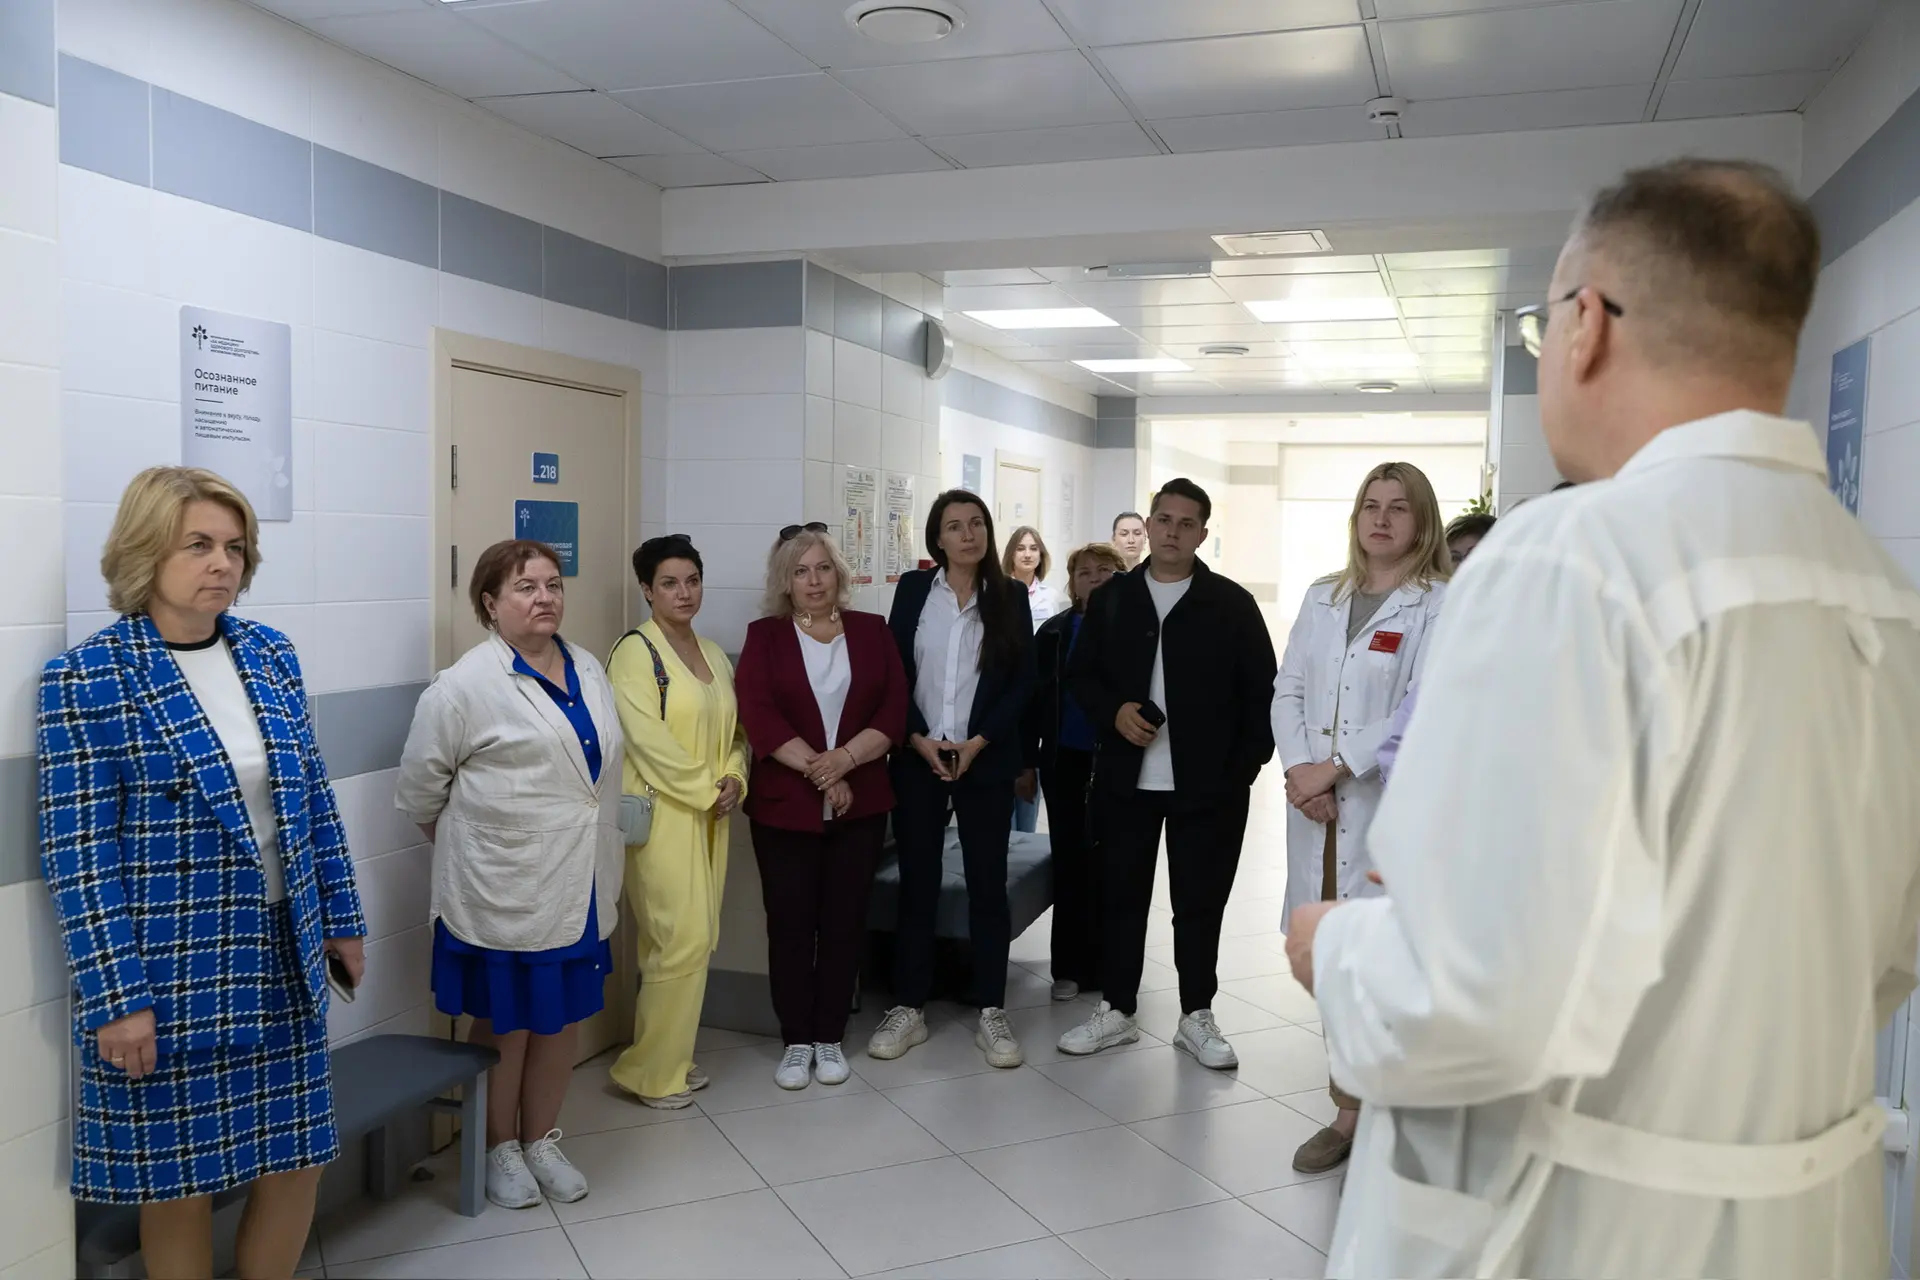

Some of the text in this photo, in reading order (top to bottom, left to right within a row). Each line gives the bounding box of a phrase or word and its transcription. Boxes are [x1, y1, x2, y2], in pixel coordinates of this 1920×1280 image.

[194, 368, 257, 386] Осознанное
[194, 382, 238, 395] питание
[194, 408, 222, 418] Внимание
[540, 464, 557, 480] 218
